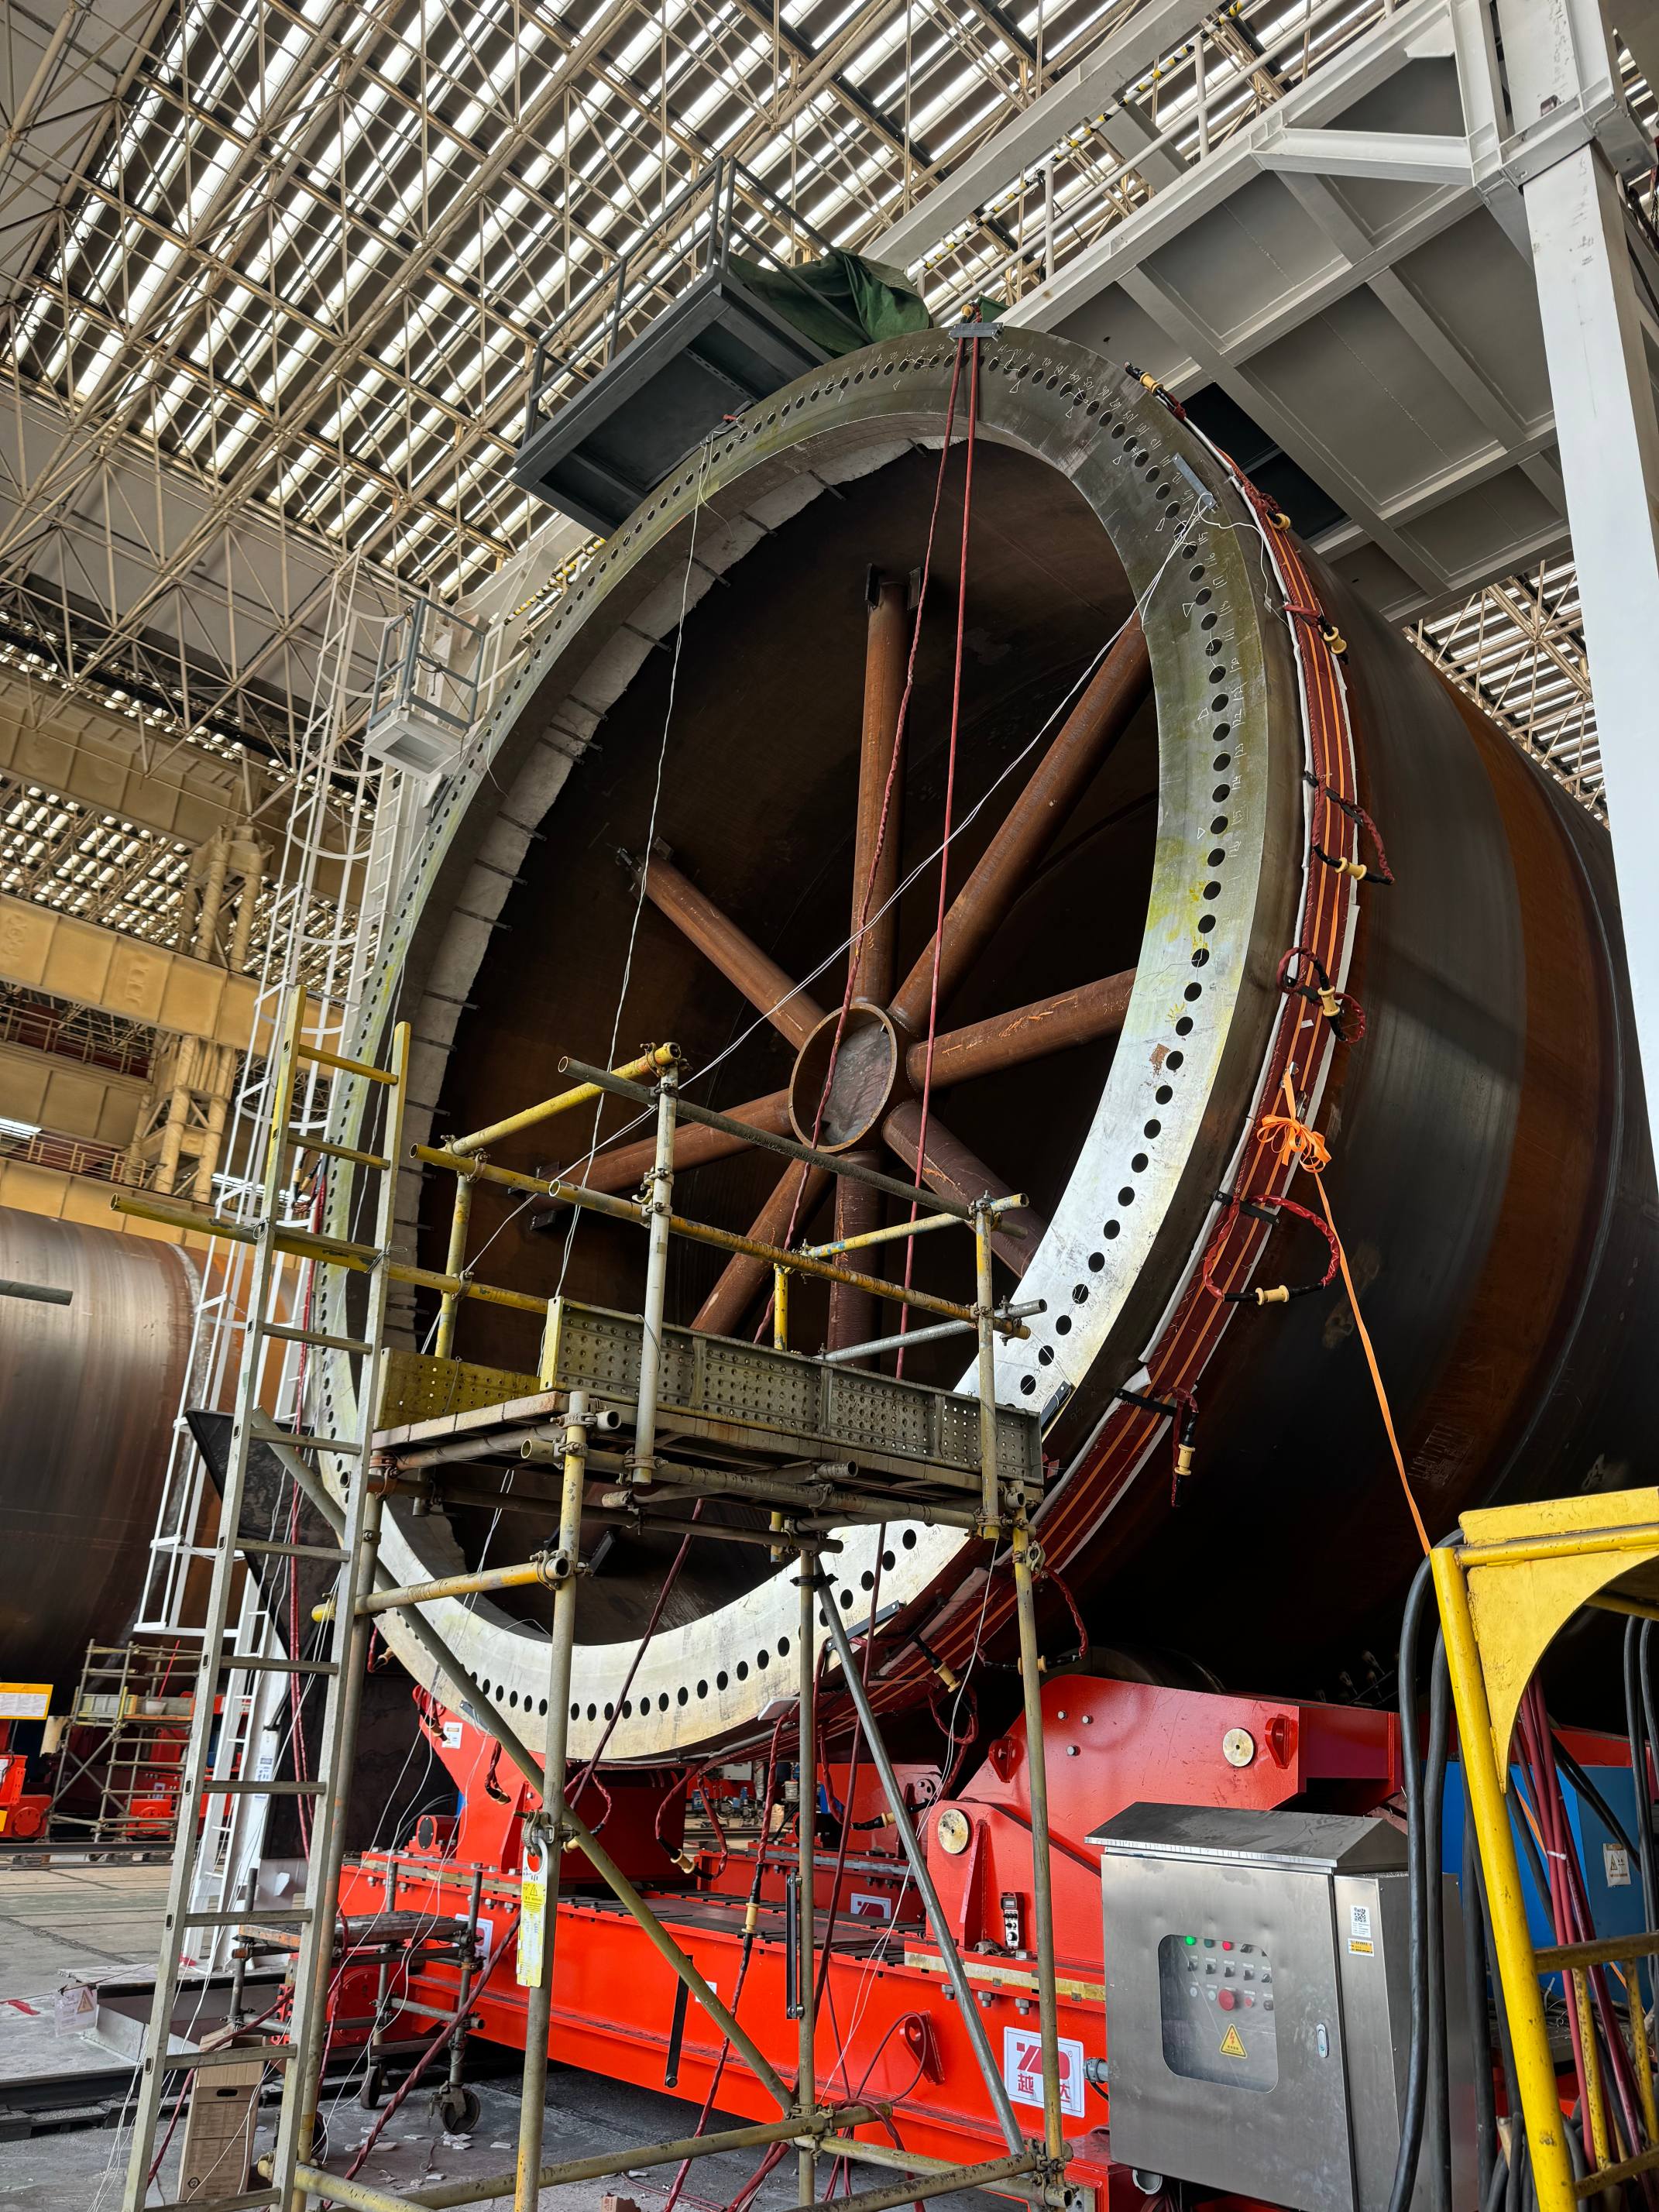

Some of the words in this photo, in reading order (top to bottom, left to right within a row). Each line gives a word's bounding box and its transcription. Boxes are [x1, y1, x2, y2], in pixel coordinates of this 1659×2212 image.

[1097, 386, 1112, 400] 106
[1204, 552, 1218, 568] 116
[1229, 658, 1242, 673] 120
[1231, 708, 1245, 729] 122
[1233, 743, 1247, 758] 123
